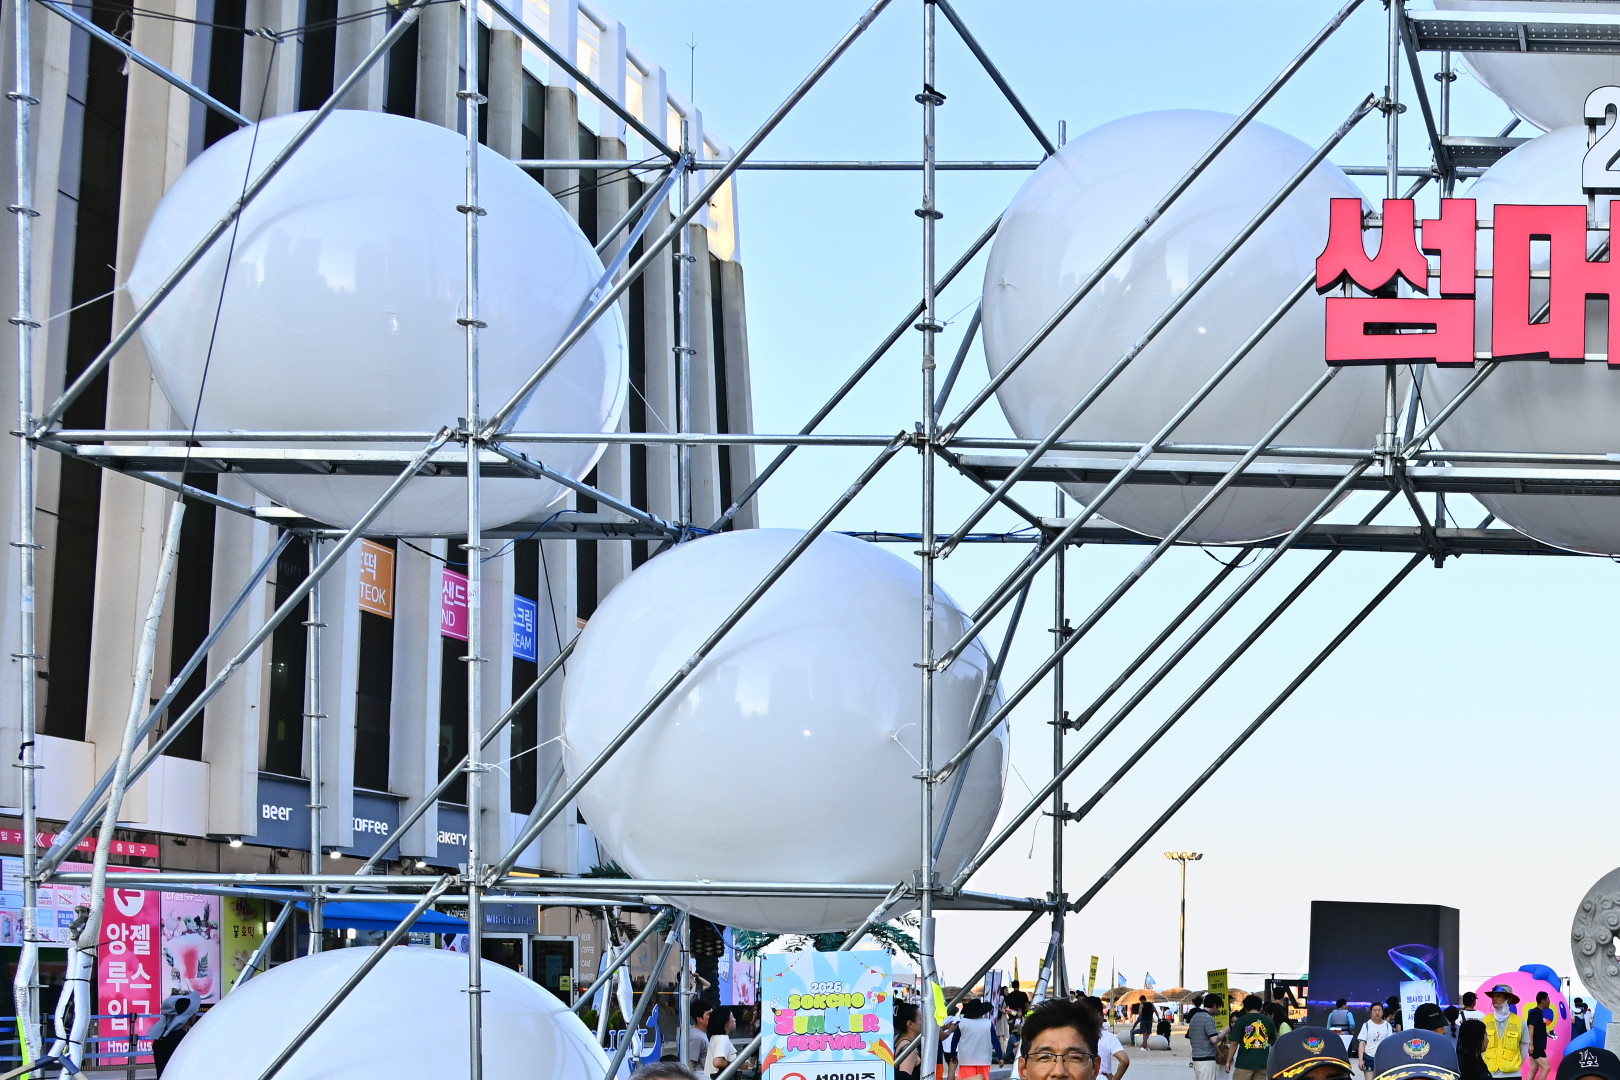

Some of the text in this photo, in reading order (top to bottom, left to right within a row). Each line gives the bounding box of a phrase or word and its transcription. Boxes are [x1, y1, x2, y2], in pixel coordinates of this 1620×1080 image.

[106, 923, 152, 956] 앙젤
[106, 961, 152, 994] 루스
[810, 981, 843, 994] 2026
[788, 992, 866, 1010] SOKCHO
[107, 999, 152, 1032] 입구
[108, 1040, 153, 1059] Hnglus
[787, 1033, 867, 1052] FESTIVAL
[1578, 1048, 1600, 1068] LA
